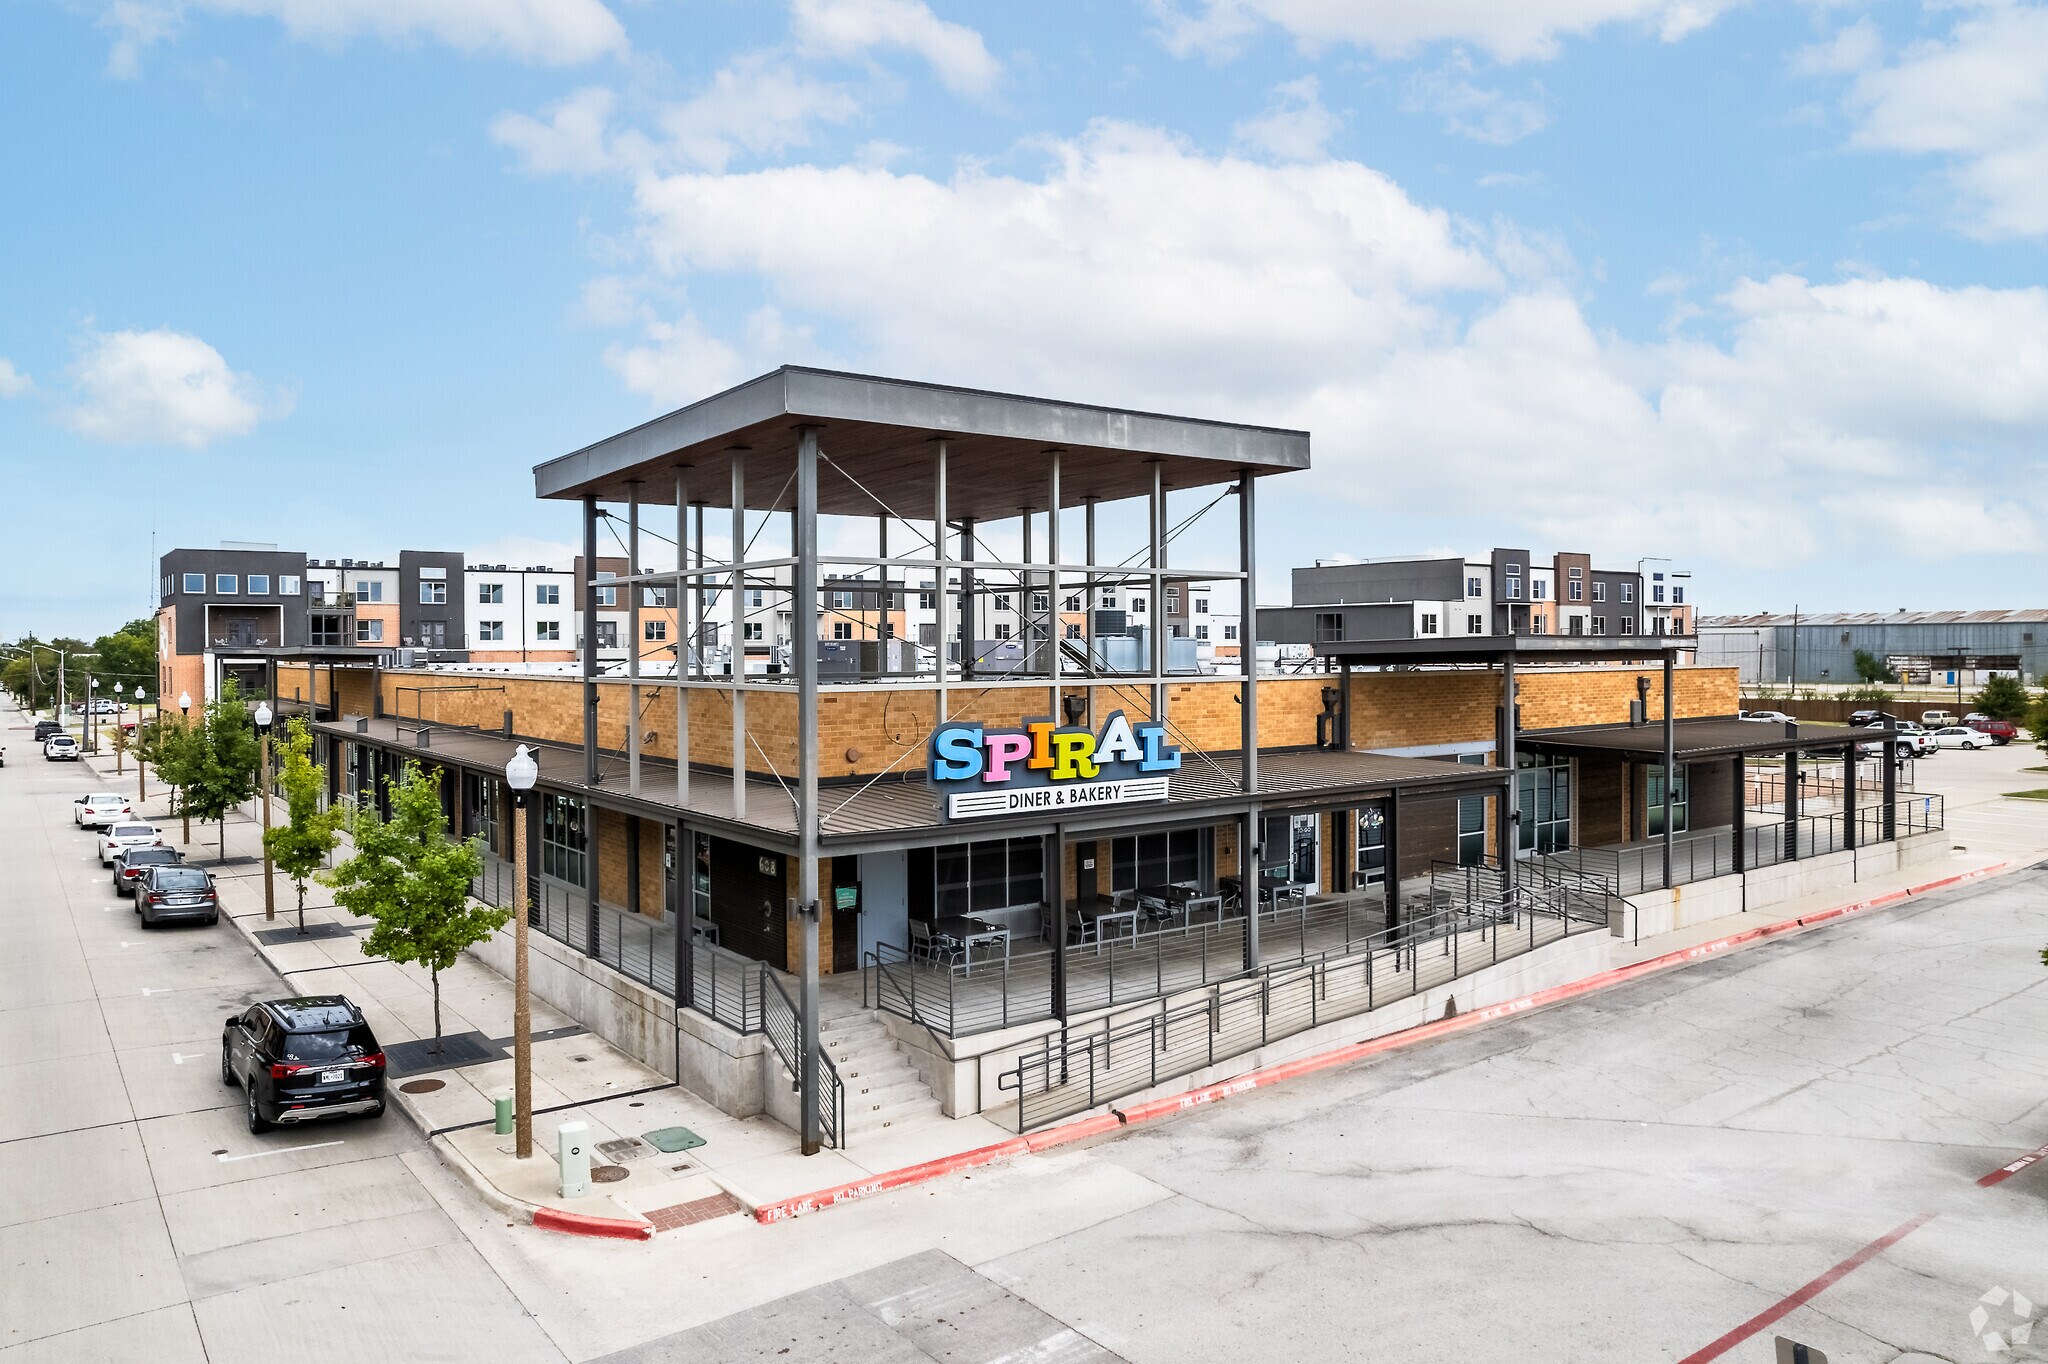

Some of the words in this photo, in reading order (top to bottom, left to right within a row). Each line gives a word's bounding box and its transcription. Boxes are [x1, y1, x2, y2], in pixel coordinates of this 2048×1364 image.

[934, 715, 1181, 782] SPIRAL
[1009, 791, 1051, 809] DINER
[1055, 790, 1065, 805] &
[1070, 785, 1121, 803] BAKERY
[759, 857, 776, 875] 608
[767, 1206, 788, 1220] FIRE
[789, 1199, 814, 1215] LANE
[833, 1192, 845, 1204] NO
[848, 1182, 883, 1201] PARKING
